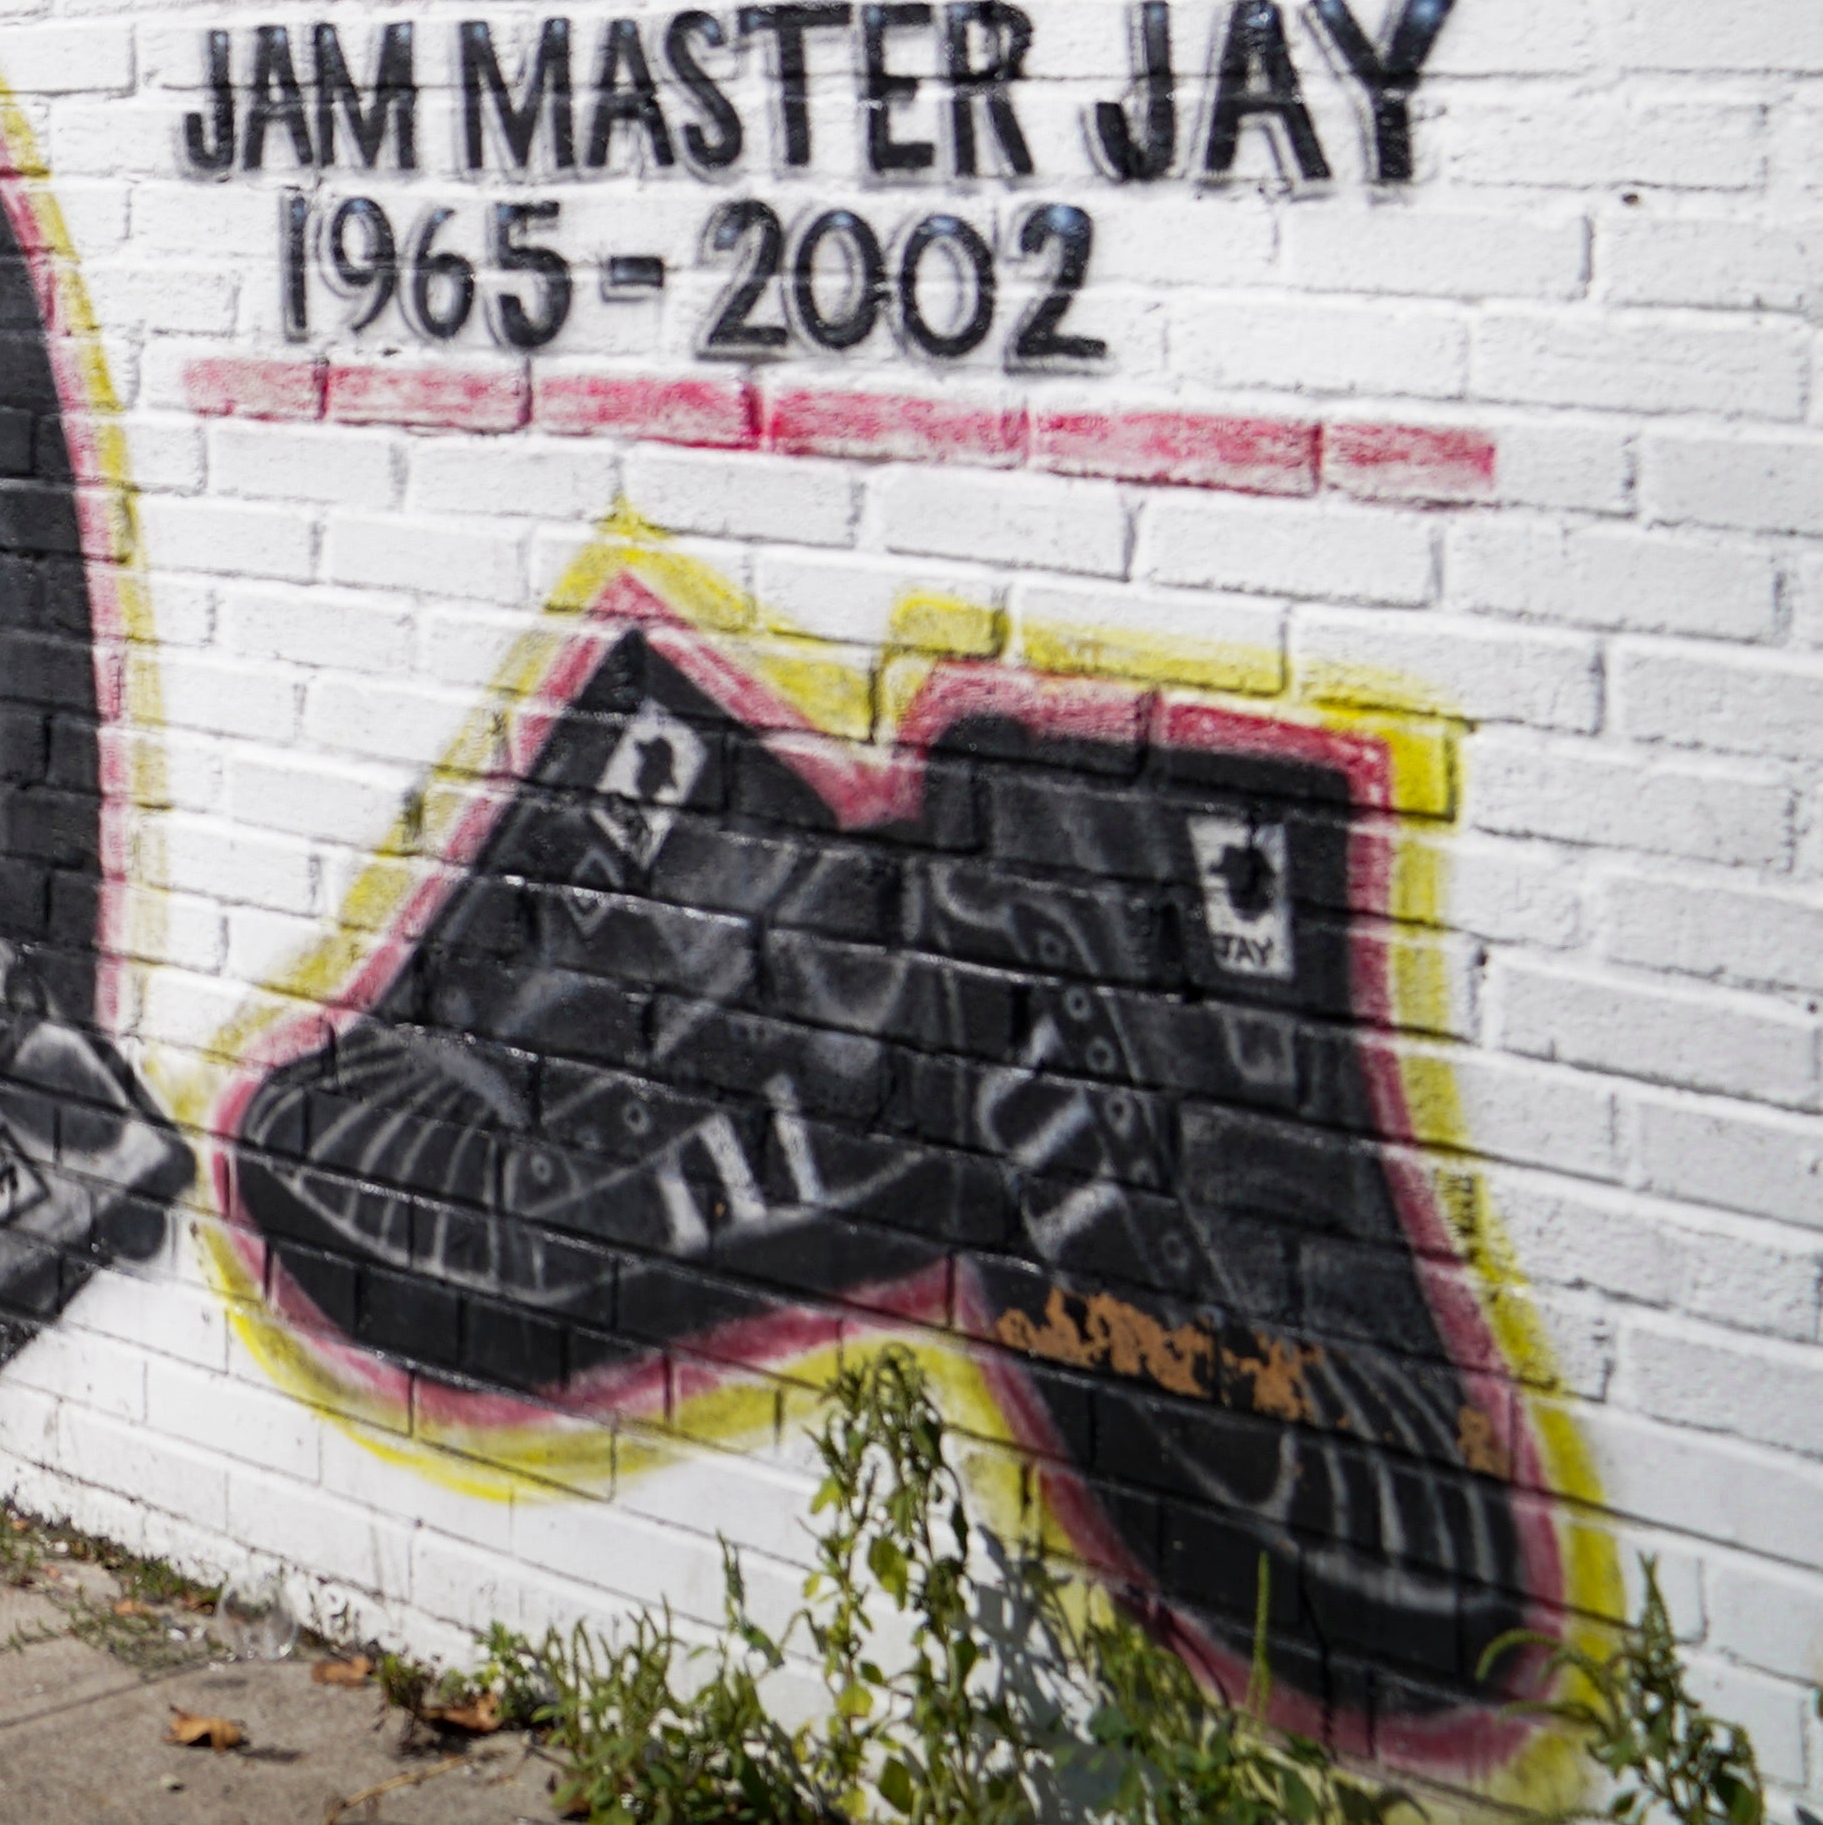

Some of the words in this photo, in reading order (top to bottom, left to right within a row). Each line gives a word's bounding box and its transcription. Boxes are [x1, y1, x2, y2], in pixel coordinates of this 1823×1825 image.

[182, 20, 421, 175] JAM
[453, 0, 1043, 181] MASTER
[1221, 933, 1274, 968] JAY
